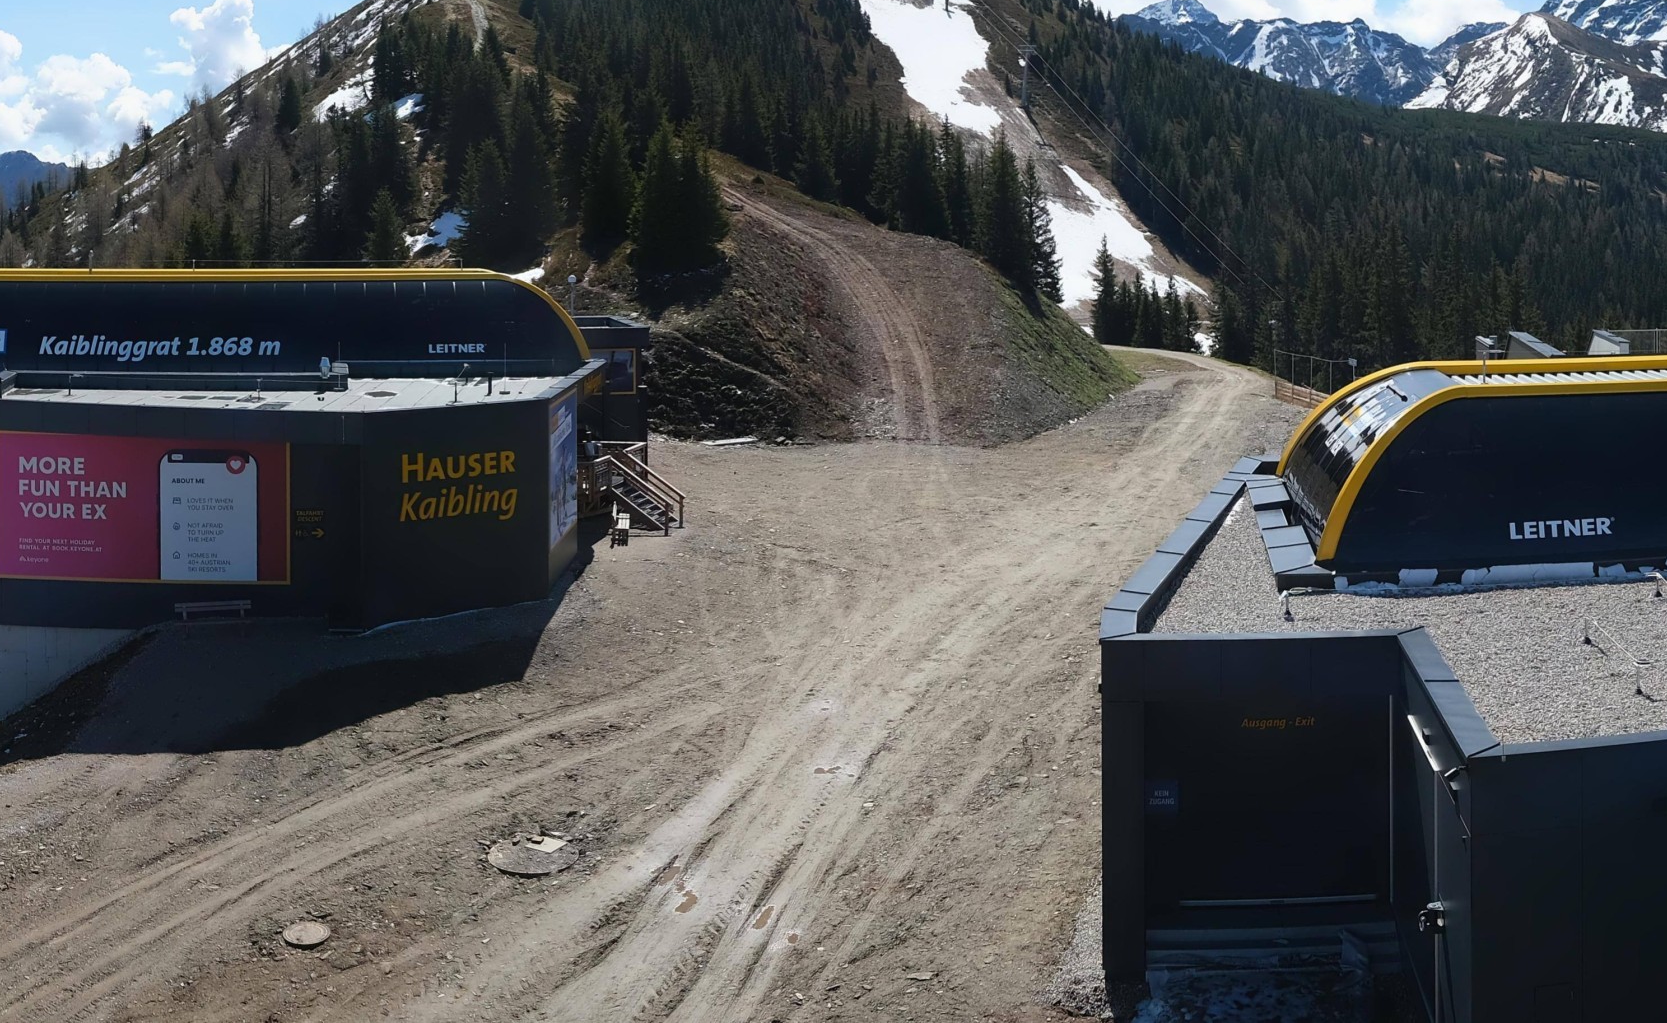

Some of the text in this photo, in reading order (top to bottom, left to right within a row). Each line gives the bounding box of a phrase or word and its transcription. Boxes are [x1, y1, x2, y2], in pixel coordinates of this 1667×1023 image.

[39, 334, 281, 362] Kaiblinggrat 1.868 m
[428, 343, 486, 354] LEITNER
[18, 456, 85, 475] MORE
[401, 450, 516, 483] HAUSER
[18, 479, 127, 498] FUN THAN
[19, 502, 107, 520] YOUR EX
[399, 484, 518, 522] Kaibling
[1509, 517, 1613, 540] LEITNER
[1240, 718, 1287, 730] Ausgang
[1295, 716, 1315, 727] Exit
[1149, 797, 1175, 805] ZUGANG
